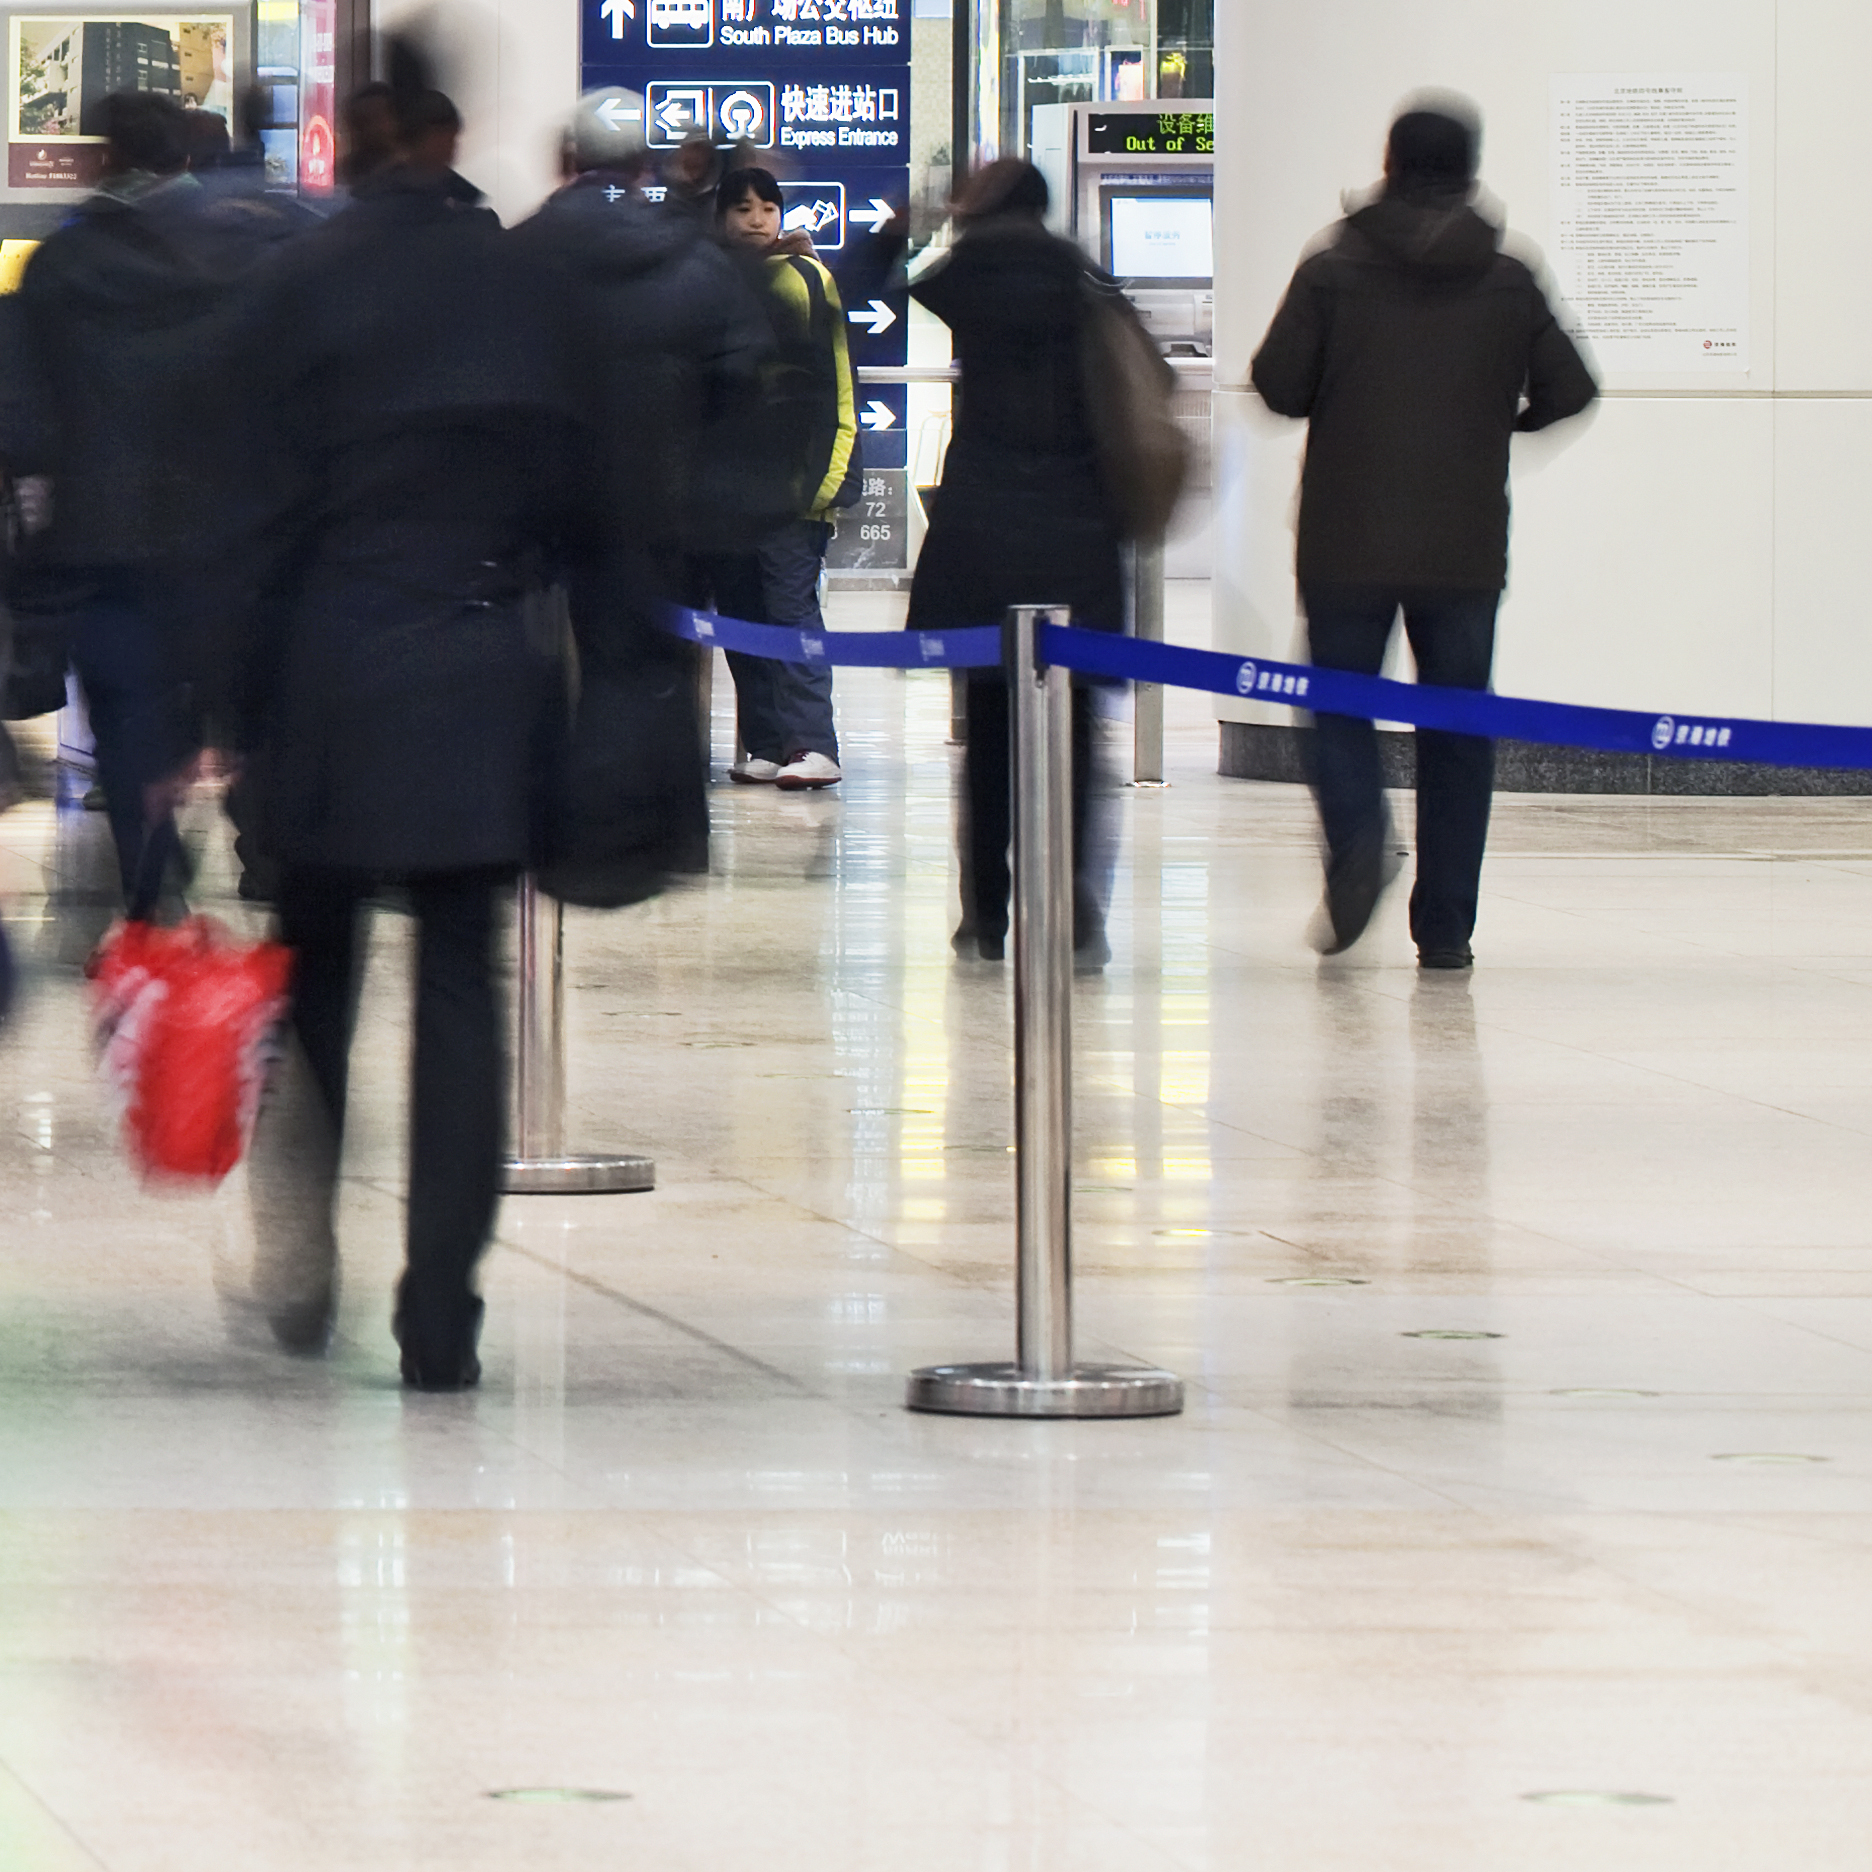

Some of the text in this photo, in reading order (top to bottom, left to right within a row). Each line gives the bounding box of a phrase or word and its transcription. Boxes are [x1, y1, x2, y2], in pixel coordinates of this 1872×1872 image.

[720, 26, 898, 45] South Plaza Bus Hub
[781, 84, 898, 122] 快速进站口
[781, 126, 898, 148] Express Entrance
[1126, 136, 1156, 151] Out
[1166, 137, 1185, 151] of
[866, 500, 888, 517] 72
[861, 525, 891, 542] 665
